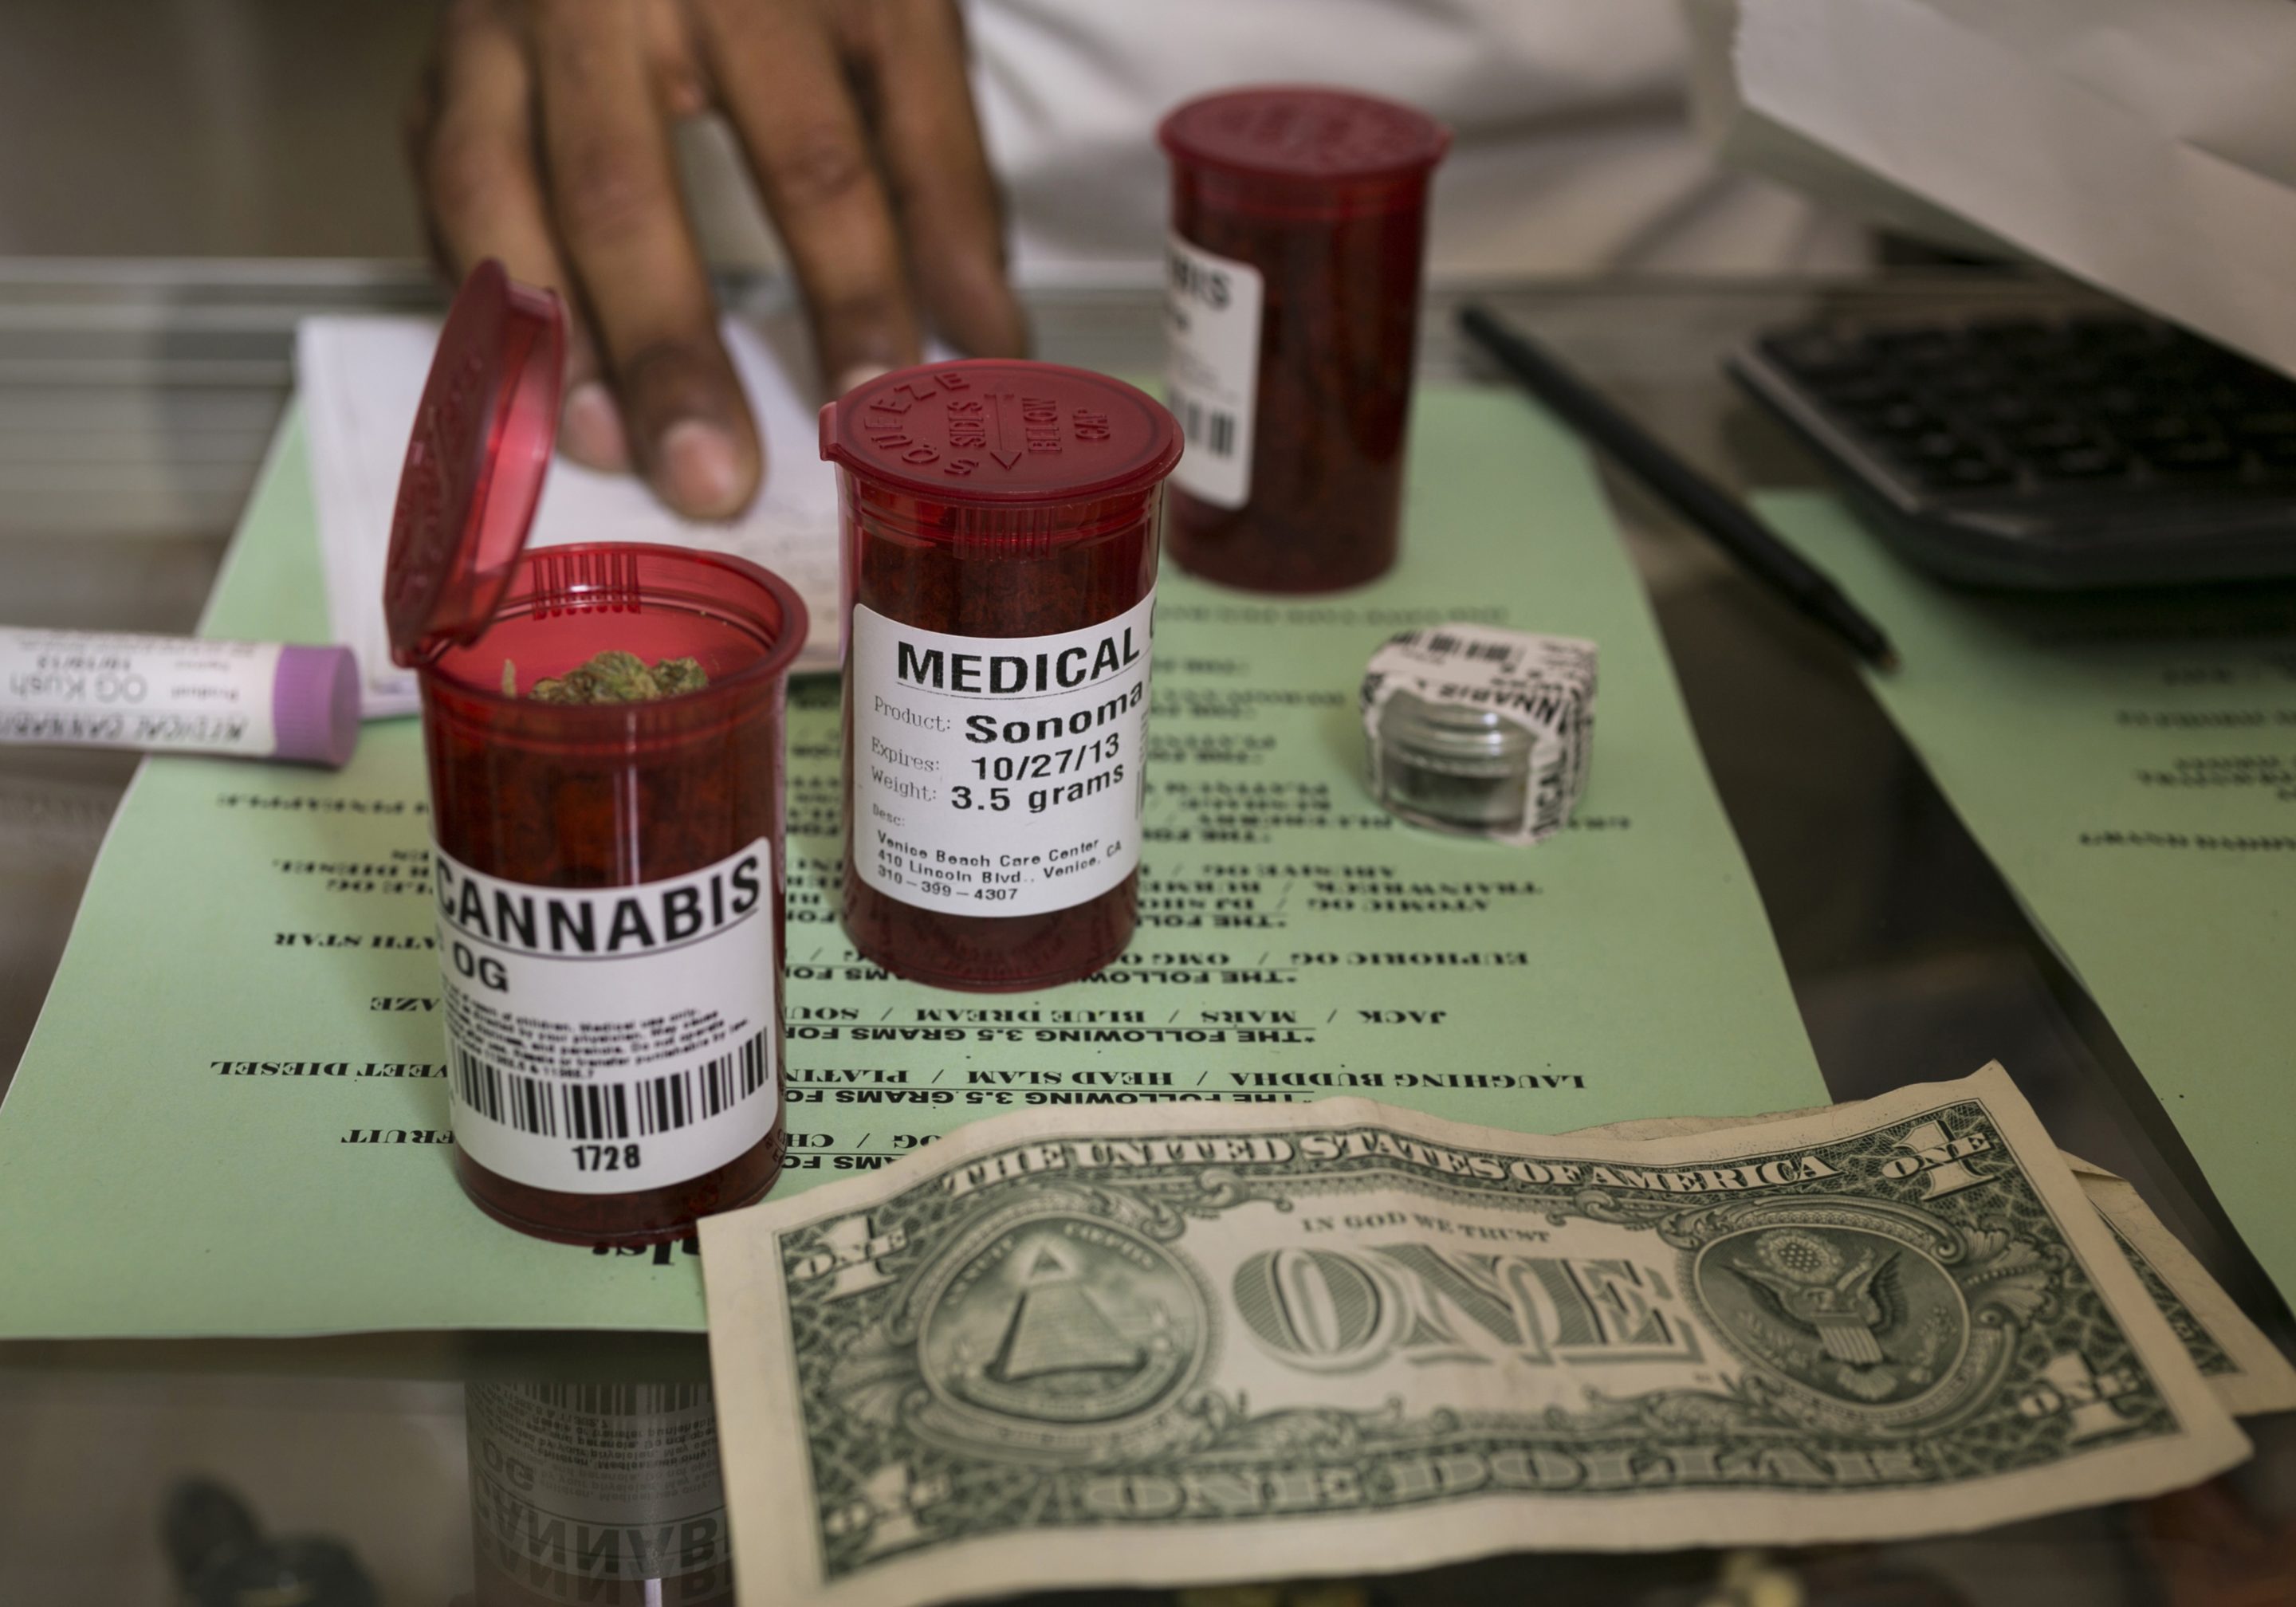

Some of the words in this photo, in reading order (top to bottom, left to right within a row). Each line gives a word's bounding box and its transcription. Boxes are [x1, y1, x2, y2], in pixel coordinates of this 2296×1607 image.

[863, 372, 979, 476] SQUEEZE
[948, 401, 986, 449] SIDES
[1024, 397, 1062, 453] BELOW
[1072, 407, 1110, 440] CAP
[898, 627, 1140, 694] MEDICAL
[8, 672, 85, 703] Kush
[92, 674, 148, 705] OG
[874, 695, 951, 733] Product:
[965, 681, 1143, 745] Sonoma
[871, 736, 939, 772] Expires:
[971, 733, 1119, 781] 10/27/13
[871, 765, 938, 804] Weight:
[951, 785, 1011, 811] 3.5
[1028, 763, 1123, 814] grams
[872, 803, 906, 827] Desc:
[878, 829, 928, 860] Venice
[936, 850, 990, 868] Beach
[1000, 855, 1041, 867] Care
[1048, 839, 1099, 862] Center
[878, 849, 903, 868] 410
[910, 861, 972, 883] Lincoln
[1107, 839, 1122, 858] CA
[437, 853, 761, 953] CANNABIS
[273, 932, 364, 949] STAR
[454, 941, 510, 993] OG
[1289, 952, 1339, 966] OG
[1347, 951, 1529, 966] EUPHORIC
[1078, 970, 1210, 984] FOLLOW
[784, 1006, 860, 1021] SOU
[915, 1008, 1041, 1023] DREAM
[1050, 1009, 1145, 1024] BLUE
[1200, 1010, 1297, 1024] MARS
[1356, 1009, 1448, 1024] JACK
[851, 1027, 966, 1041] GRAMS
[976, 1028, 1024, 1043] 3.5
[1035, 1028, 1226, 1043] FOLLOWING
[210, 1061, 351, 1077] DIESEL
[966, 1070, 1063, 1085] SLAM
[1071, 1071, 1174, 1086] HEAD
[1228, 1071, 1383, 1088] BUDDHA
[1393, 1073, 1585, 1089] LAUGHING
[784, 1089, 824, 1103] FO
[835, 1090, 955, 1104] GRAMS
[965, 1090, 1014, 1105] 3.5
[1024, 1091, 1221, 1105] FOLLOWING
[572, 1144, 642, 1173] 1728
[946, 1142, 1070, 1195] THE
[1073, 1134, 1299, 1169] UNITED
[1299, 1133, 1511, 1181] STATES
[1509, 1161, 1594, 1187] OF
[1590, 1154, 1850, 1193] AMERICA
[1300, 1216, 1336, 1234] IN
[1345, 1211, 1408, 1232] GOD
[1414, 1214, 1452, 1232] WE
[1456, 1223, 1551, 1245] TRUST
[1232, 1241, 1706, 1373] ONE
[1083, 1464, 1363, 1520] ONE
[1386, 1444, 1918, 1506] DOLLAR
